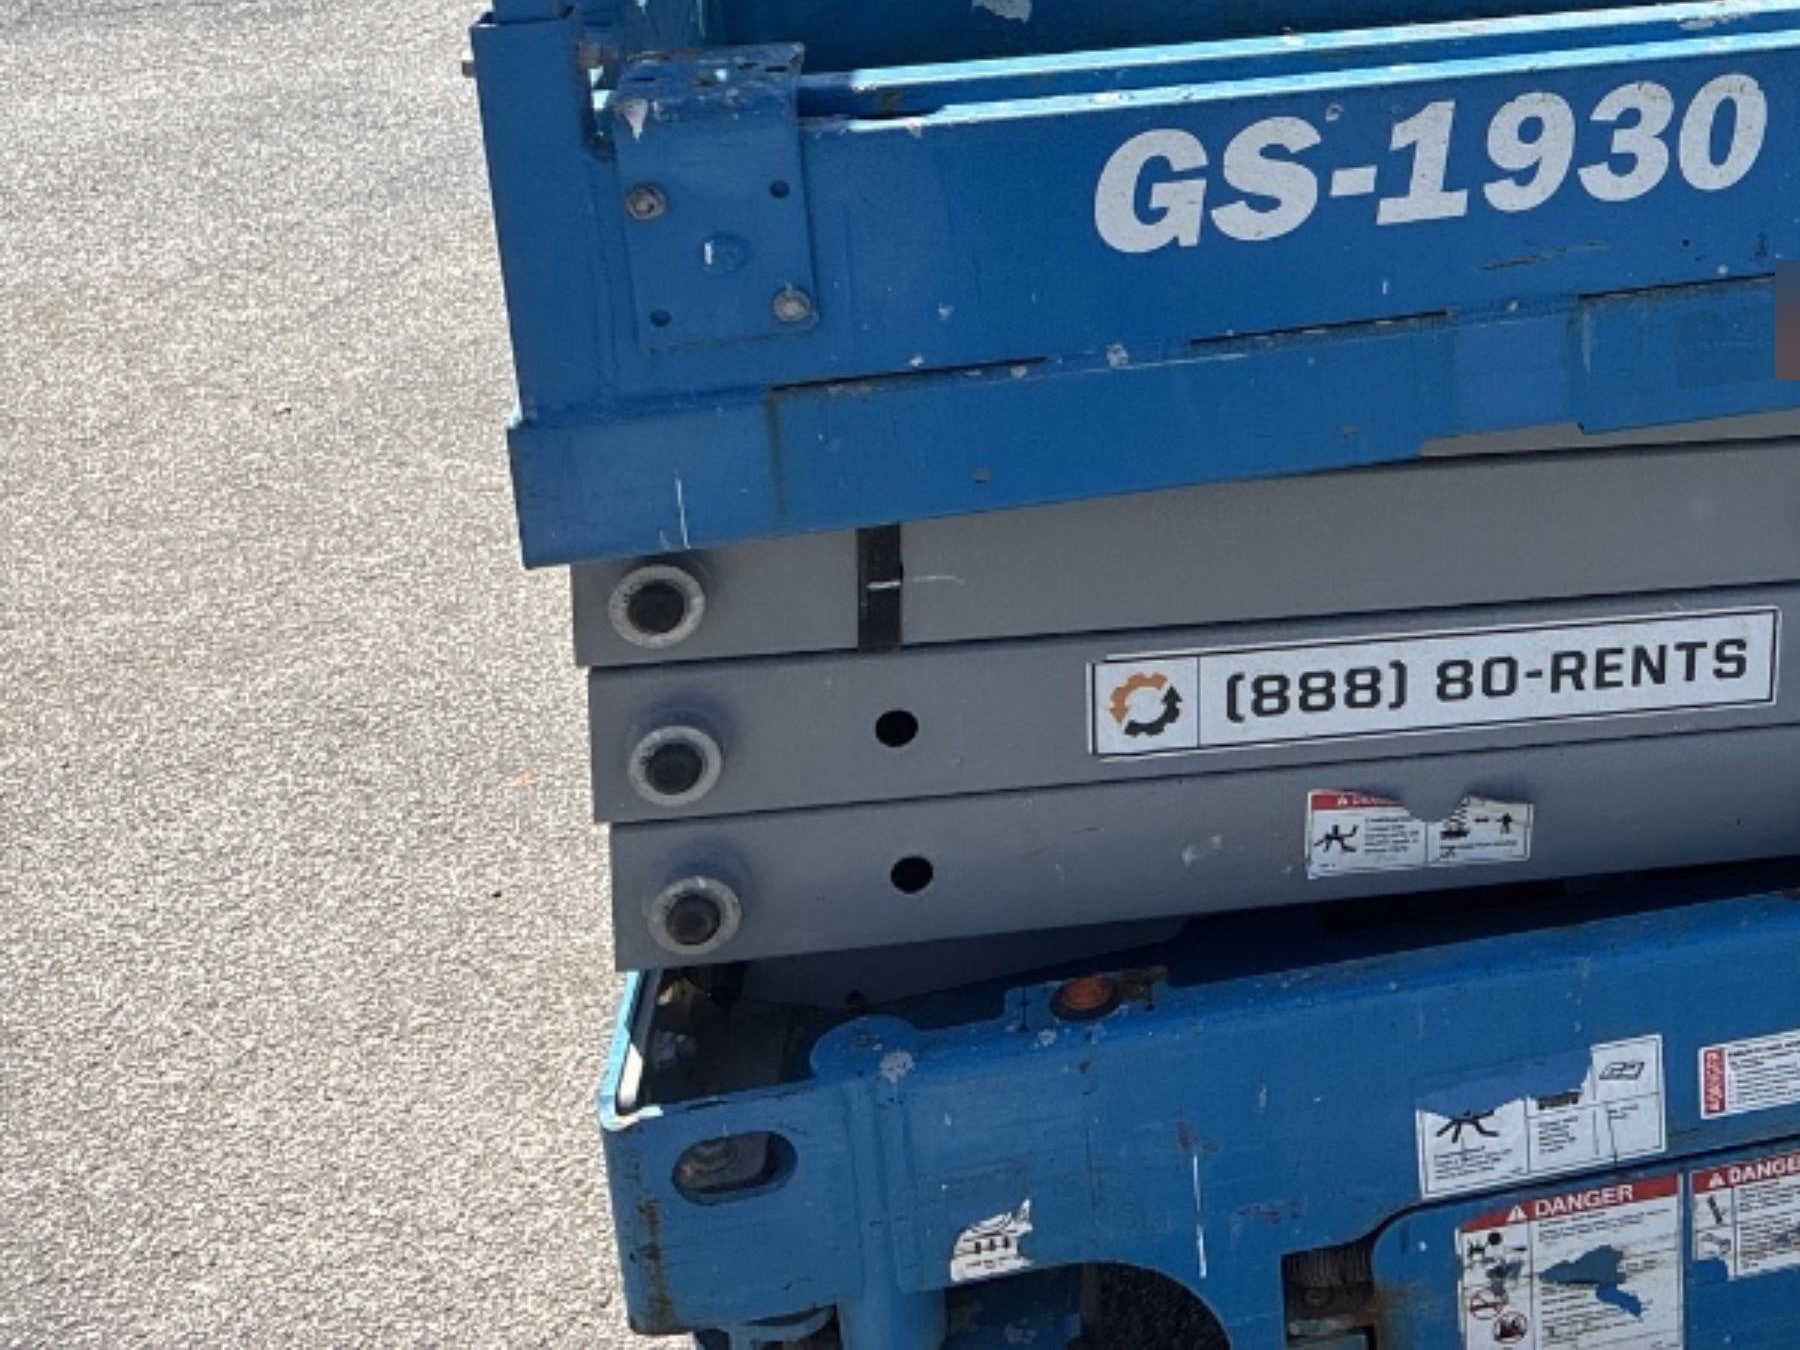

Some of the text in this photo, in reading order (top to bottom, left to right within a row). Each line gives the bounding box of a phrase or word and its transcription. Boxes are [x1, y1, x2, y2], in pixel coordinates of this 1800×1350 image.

[1094, 74, 1768, 253] GS-1930
[1226, 638, 1748, 723] (888) 80-RENTS
[1535, 1184, 1633, 1218] DANGER
